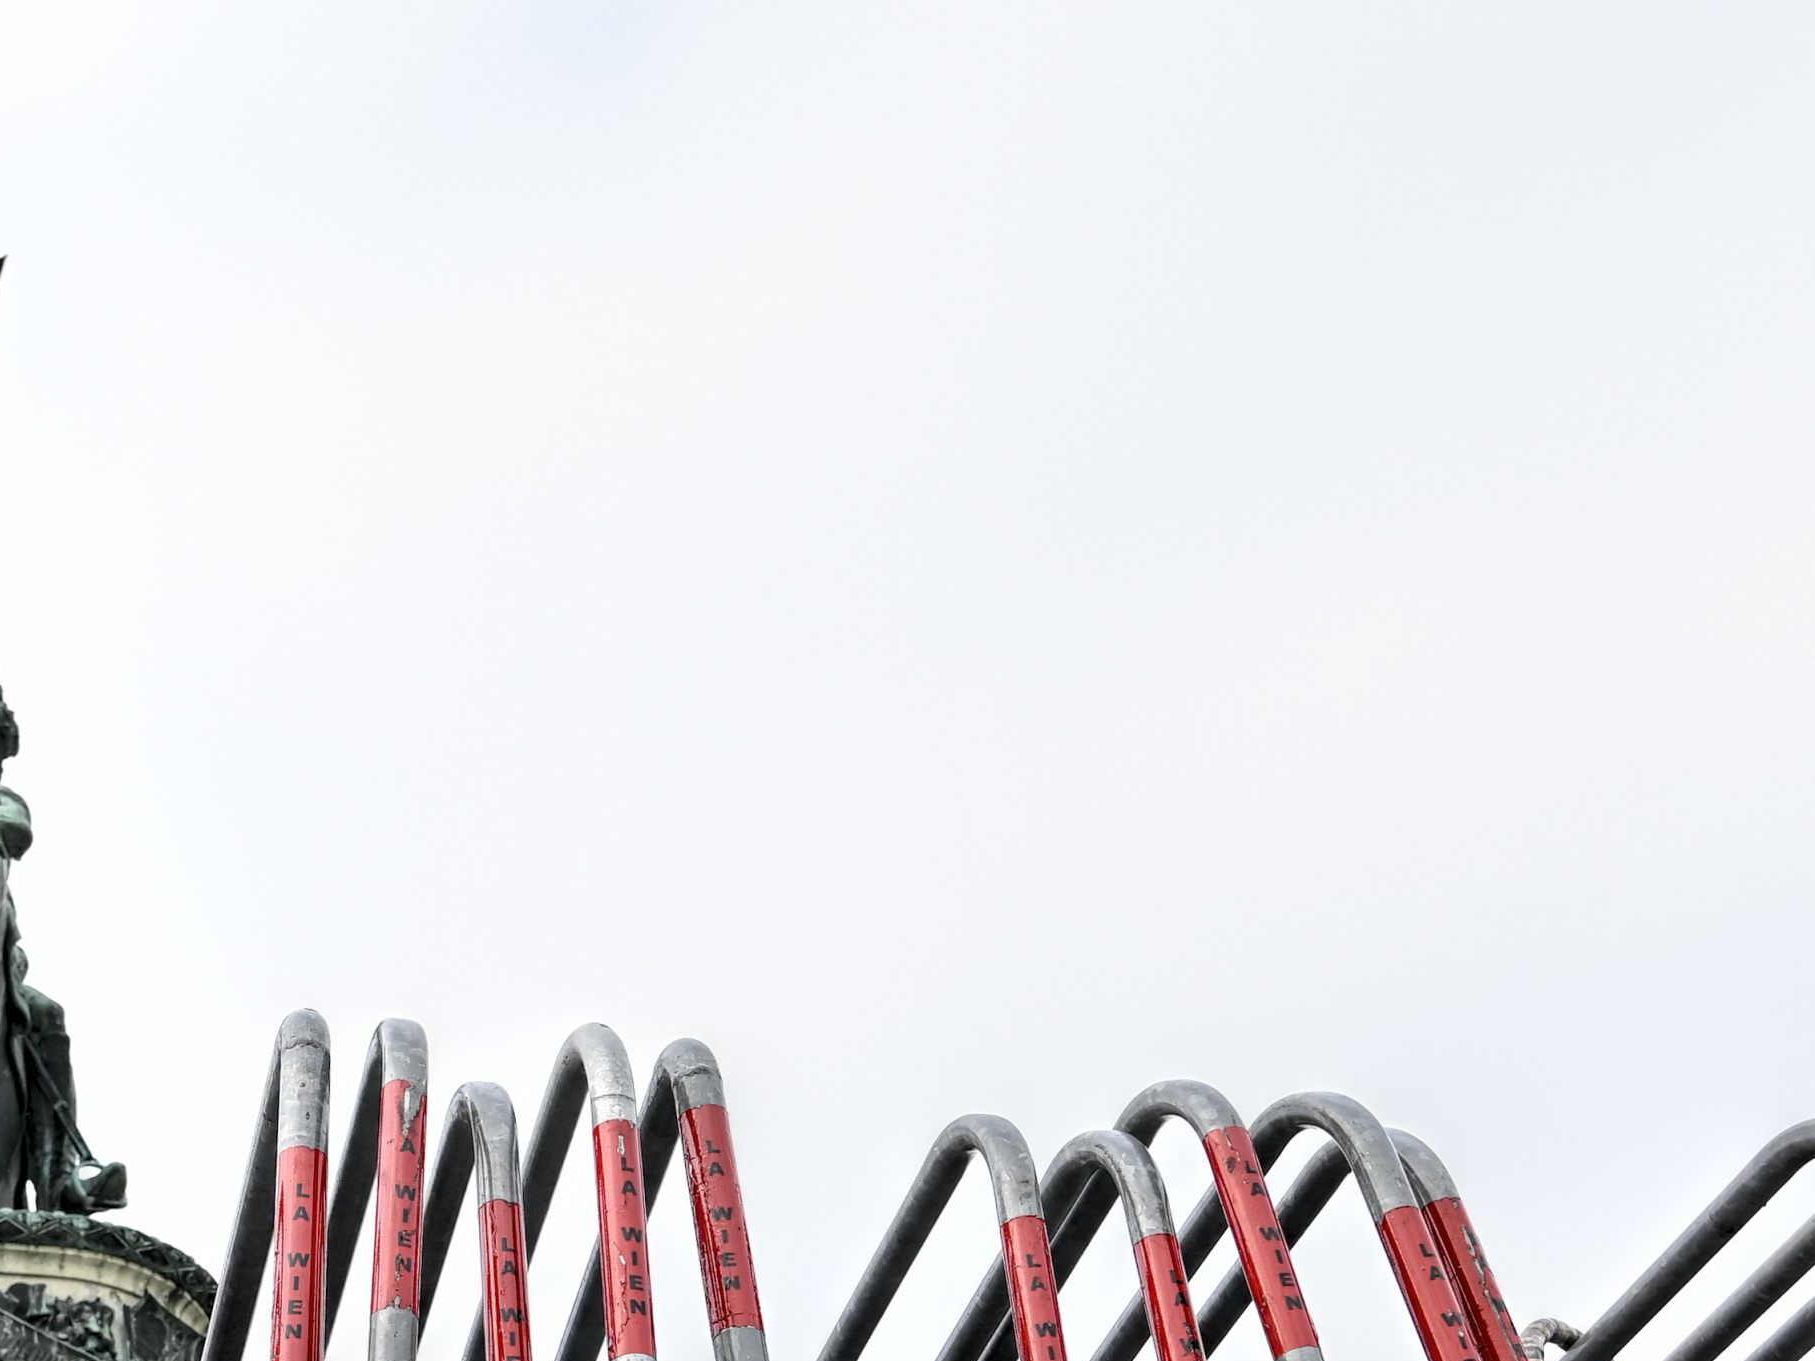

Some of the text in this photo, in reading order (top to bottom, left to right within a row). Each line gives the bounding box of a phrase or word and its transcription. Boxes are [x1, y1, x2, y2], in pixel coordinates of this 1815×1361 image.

[395, 1184, 417, 1273] WIEN
[500, 1237, 518, 1276] LA
[620, 1157, 648, 1315] LA WIEN
[706, 1139, 741, 1291] LA WIEN
[1245, 1160, 1303, 1311] LA WIEN
[285, 1183, 311, 1339] LA WIEN
[1026, 1254, 1045, 1293] LA
[1169, 1270, 1188, 1306] LA
[1419, 1243, 1445, 1281] LA
